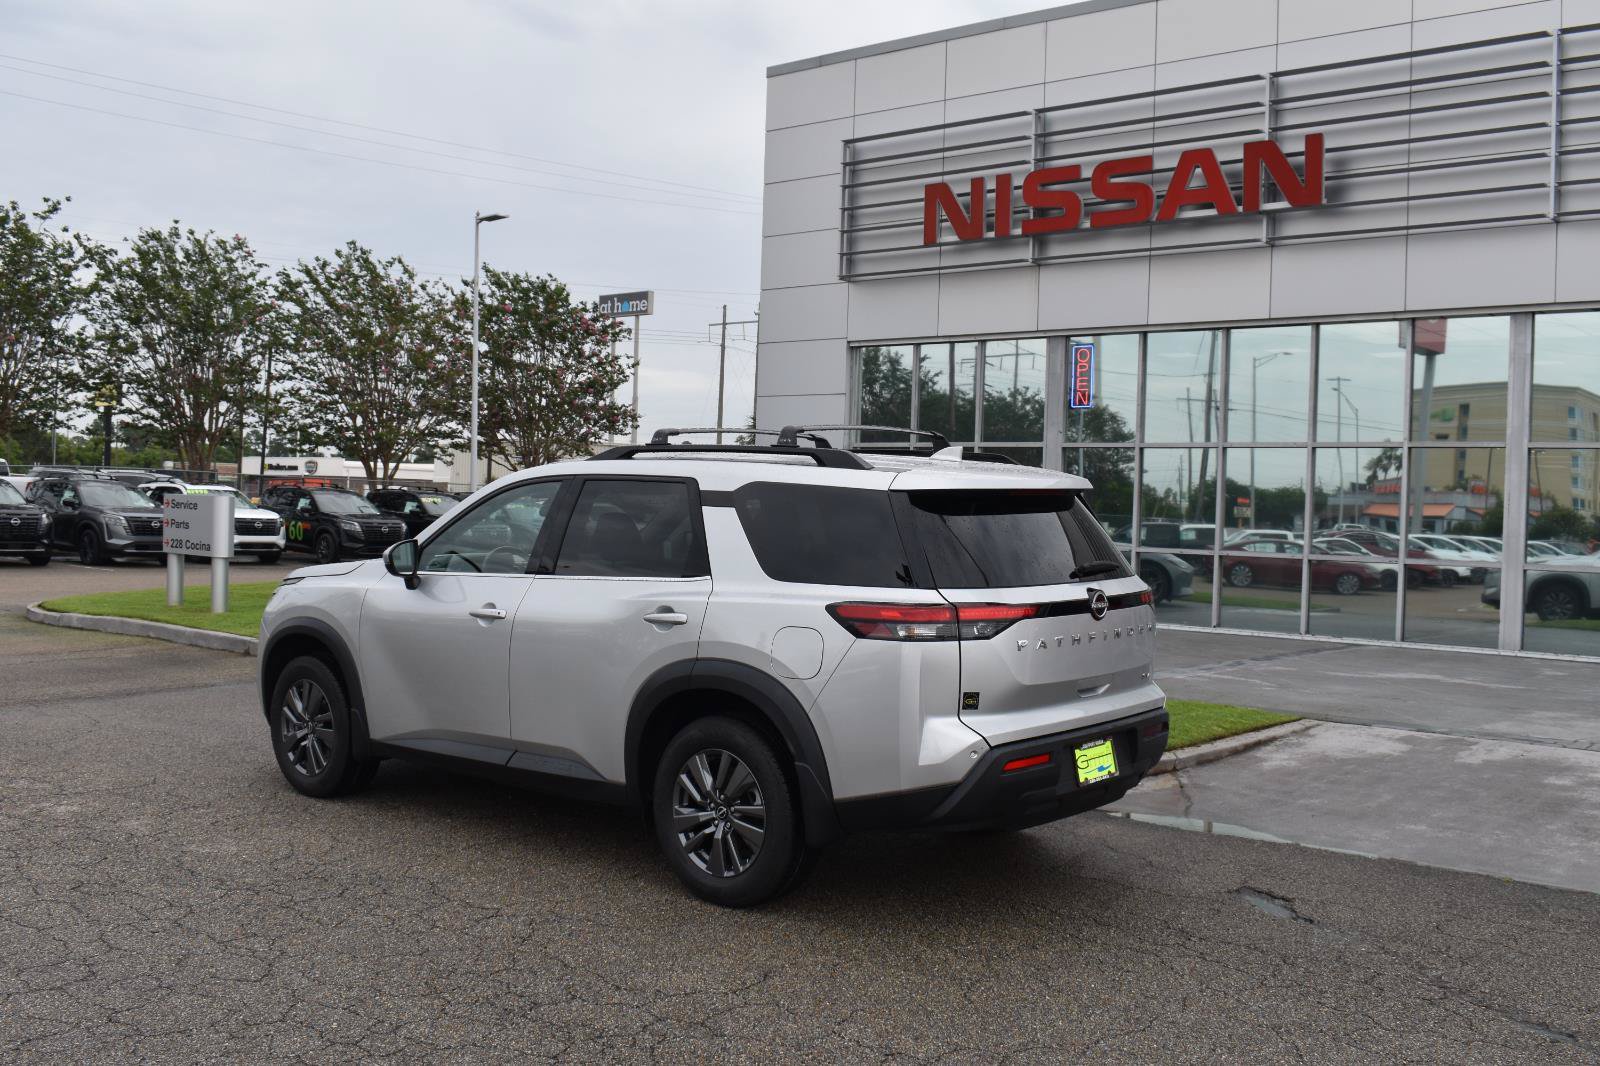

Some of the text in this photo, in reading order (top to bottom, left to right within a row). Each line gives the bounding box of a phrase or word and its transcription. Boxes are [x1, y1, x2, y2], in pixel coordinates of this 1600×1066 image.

[923, 133, 1324, 245] NISSAN
[600, 300, 612, 314] at
[1076, 348, 1090, 406] OPEN
[170, 499, 198, 511] Service
[170, 519, 190, 530] Parts
[289, 520, 304, 541] 60
[170, 538, 211, 552] 228 Cocina
